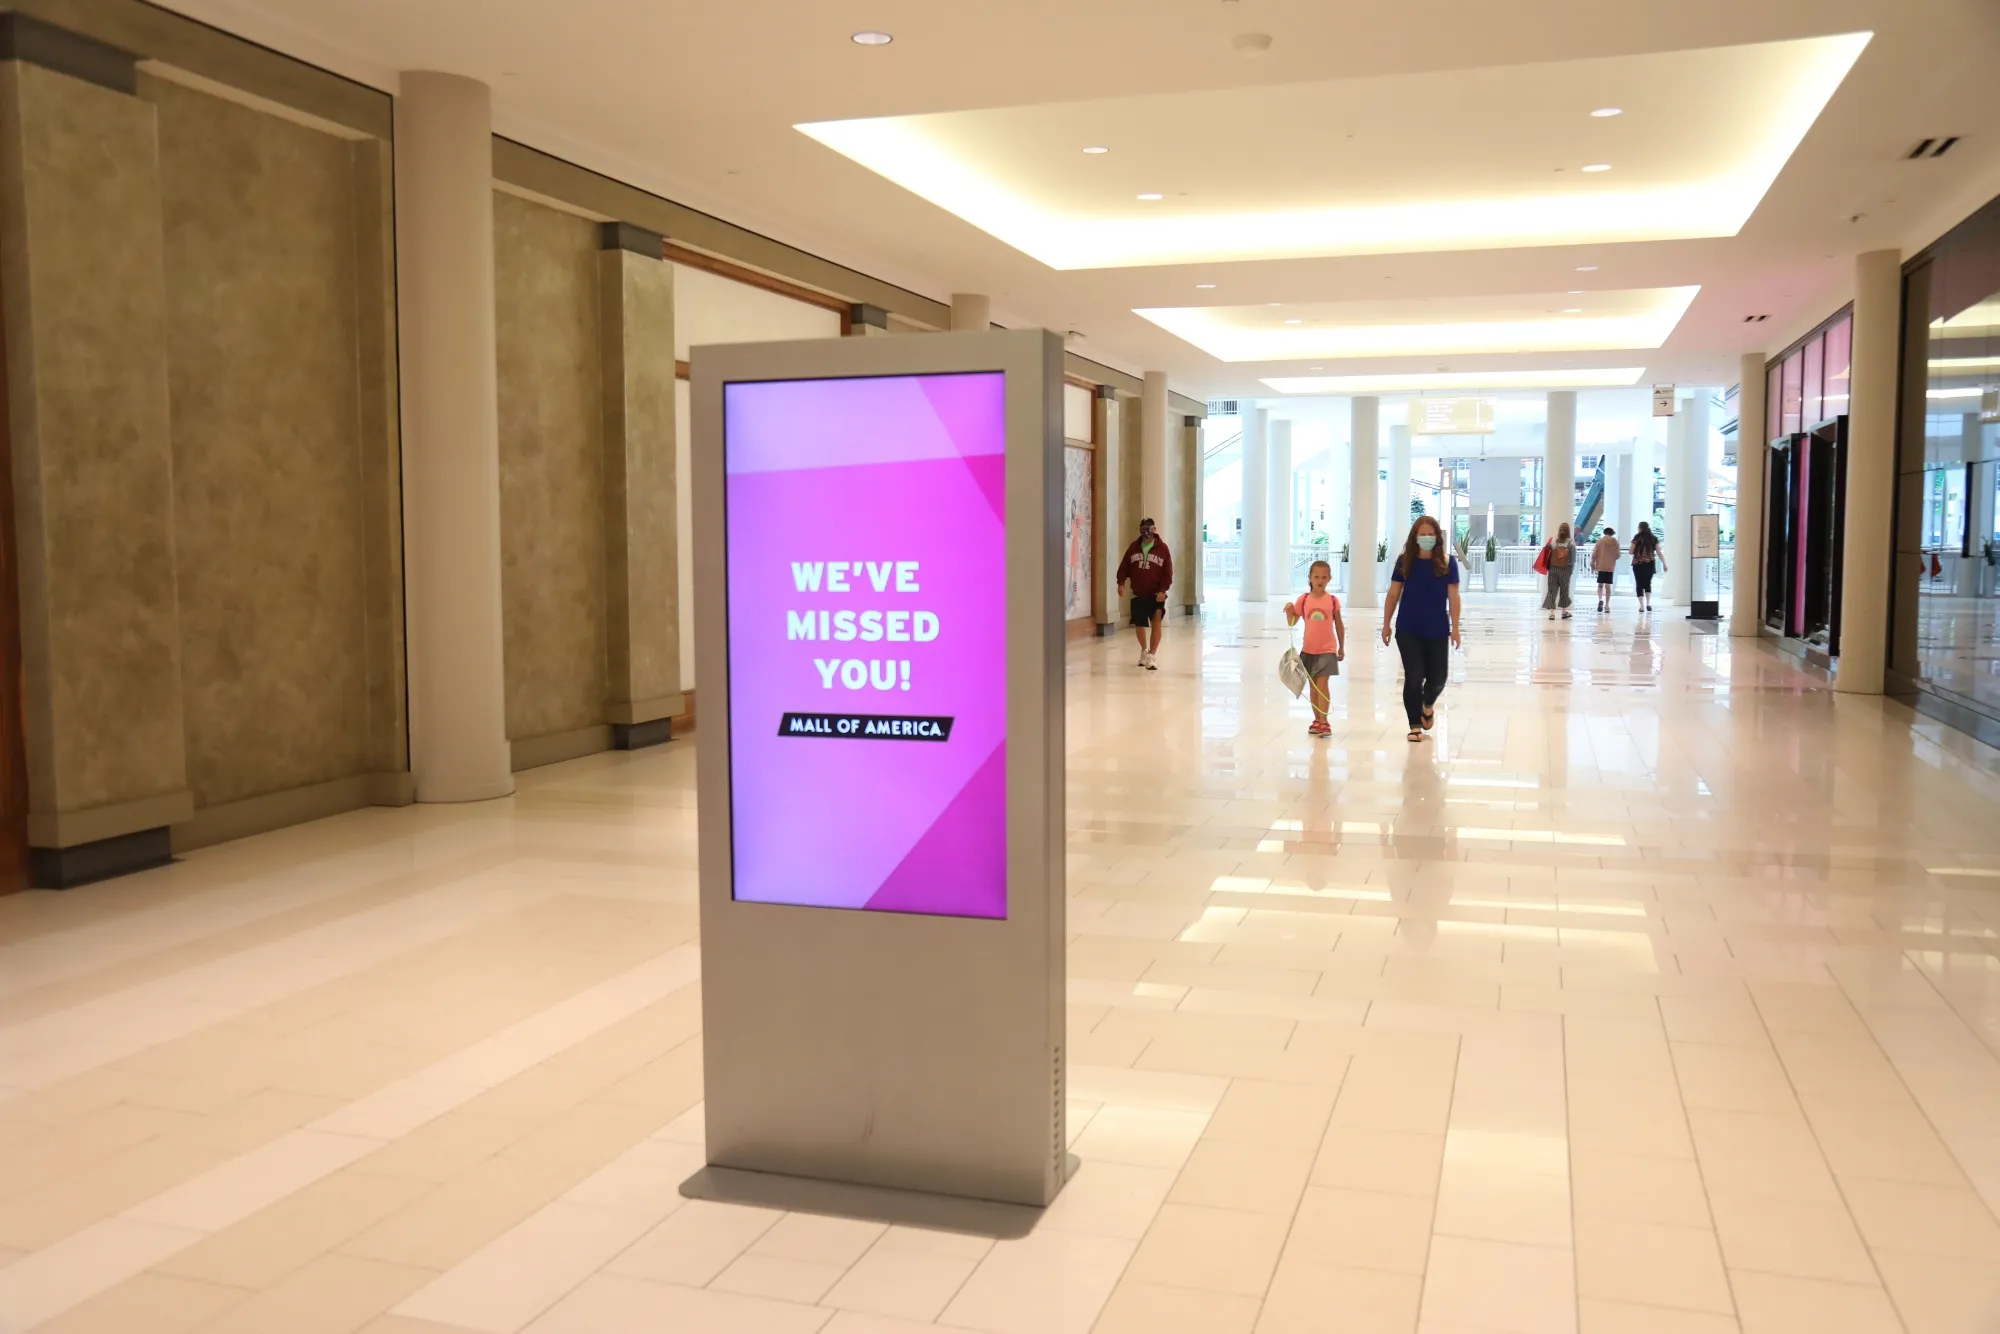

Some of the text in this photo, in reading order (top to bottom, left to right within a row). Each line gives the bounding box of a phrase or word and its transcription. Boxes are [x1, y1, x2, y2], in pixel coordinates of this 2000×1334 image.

[791, 561, 920, 592] WE'VE
[787, 610, 940, 642] MISSED
[813, 659, 911, 691] YOU!
[790, 717, 942, 737] MALL OF AMERICA
